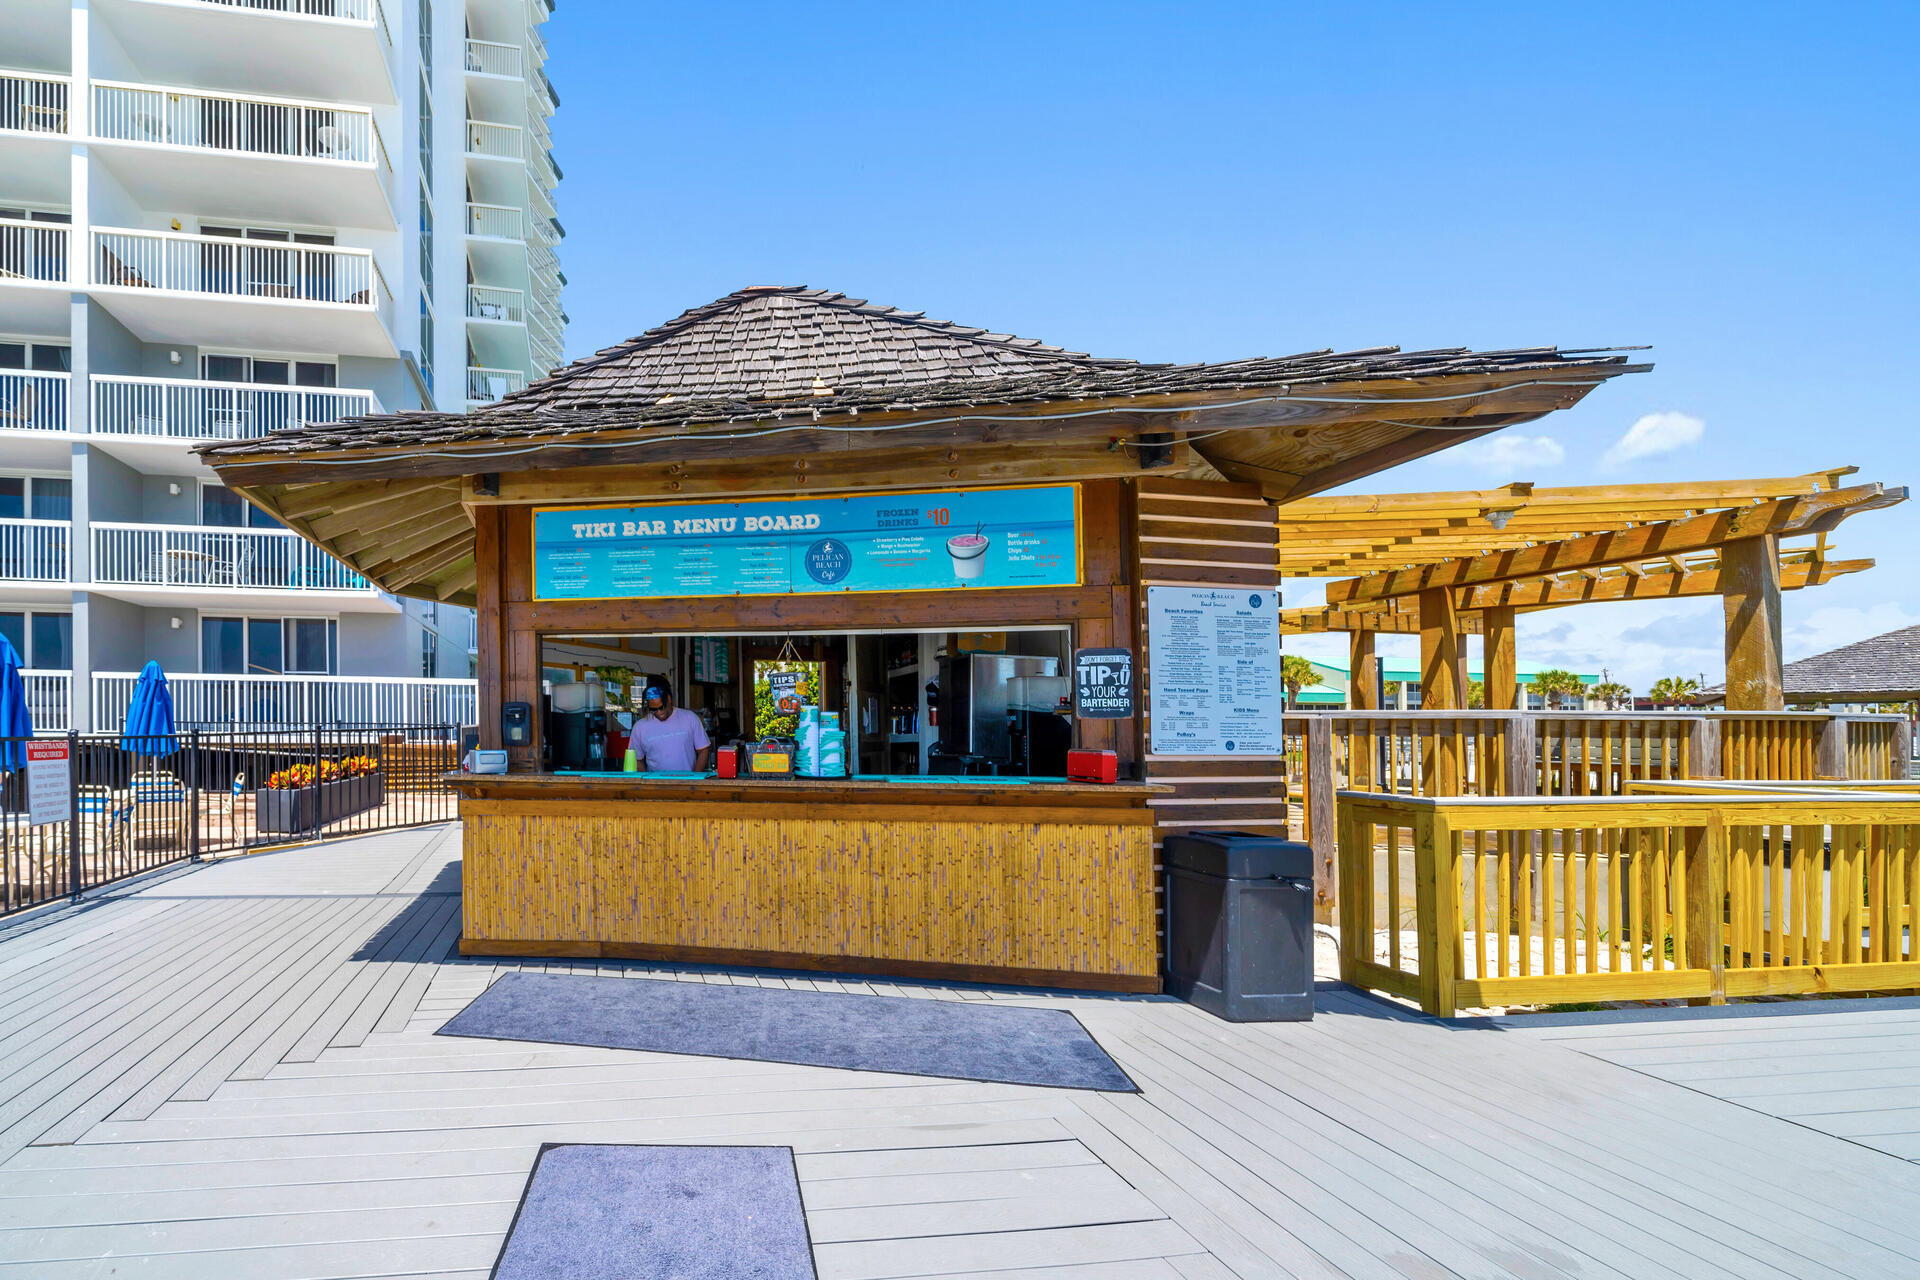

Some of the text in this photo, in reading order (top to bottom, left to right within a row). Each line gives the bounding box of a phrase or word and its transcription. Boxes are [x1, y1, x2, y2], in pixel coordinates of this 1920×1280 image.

[876, 507, 950, 526] FROZEN $10
[572, 514, 821, 538] TIKI BAR MENU BOARD
[877, 518, 919, 528] DRINKS
[812, 553, 844, 561] PELICAN
[815, 561, 841, 569] BEACH
[773, 675, 795, 683] TIPS
[1077, 665, 1111, 685] TIP
[1092, 686, 1117, 697] YOUR
[1081, 698, 1130, 707] BARTENDER
